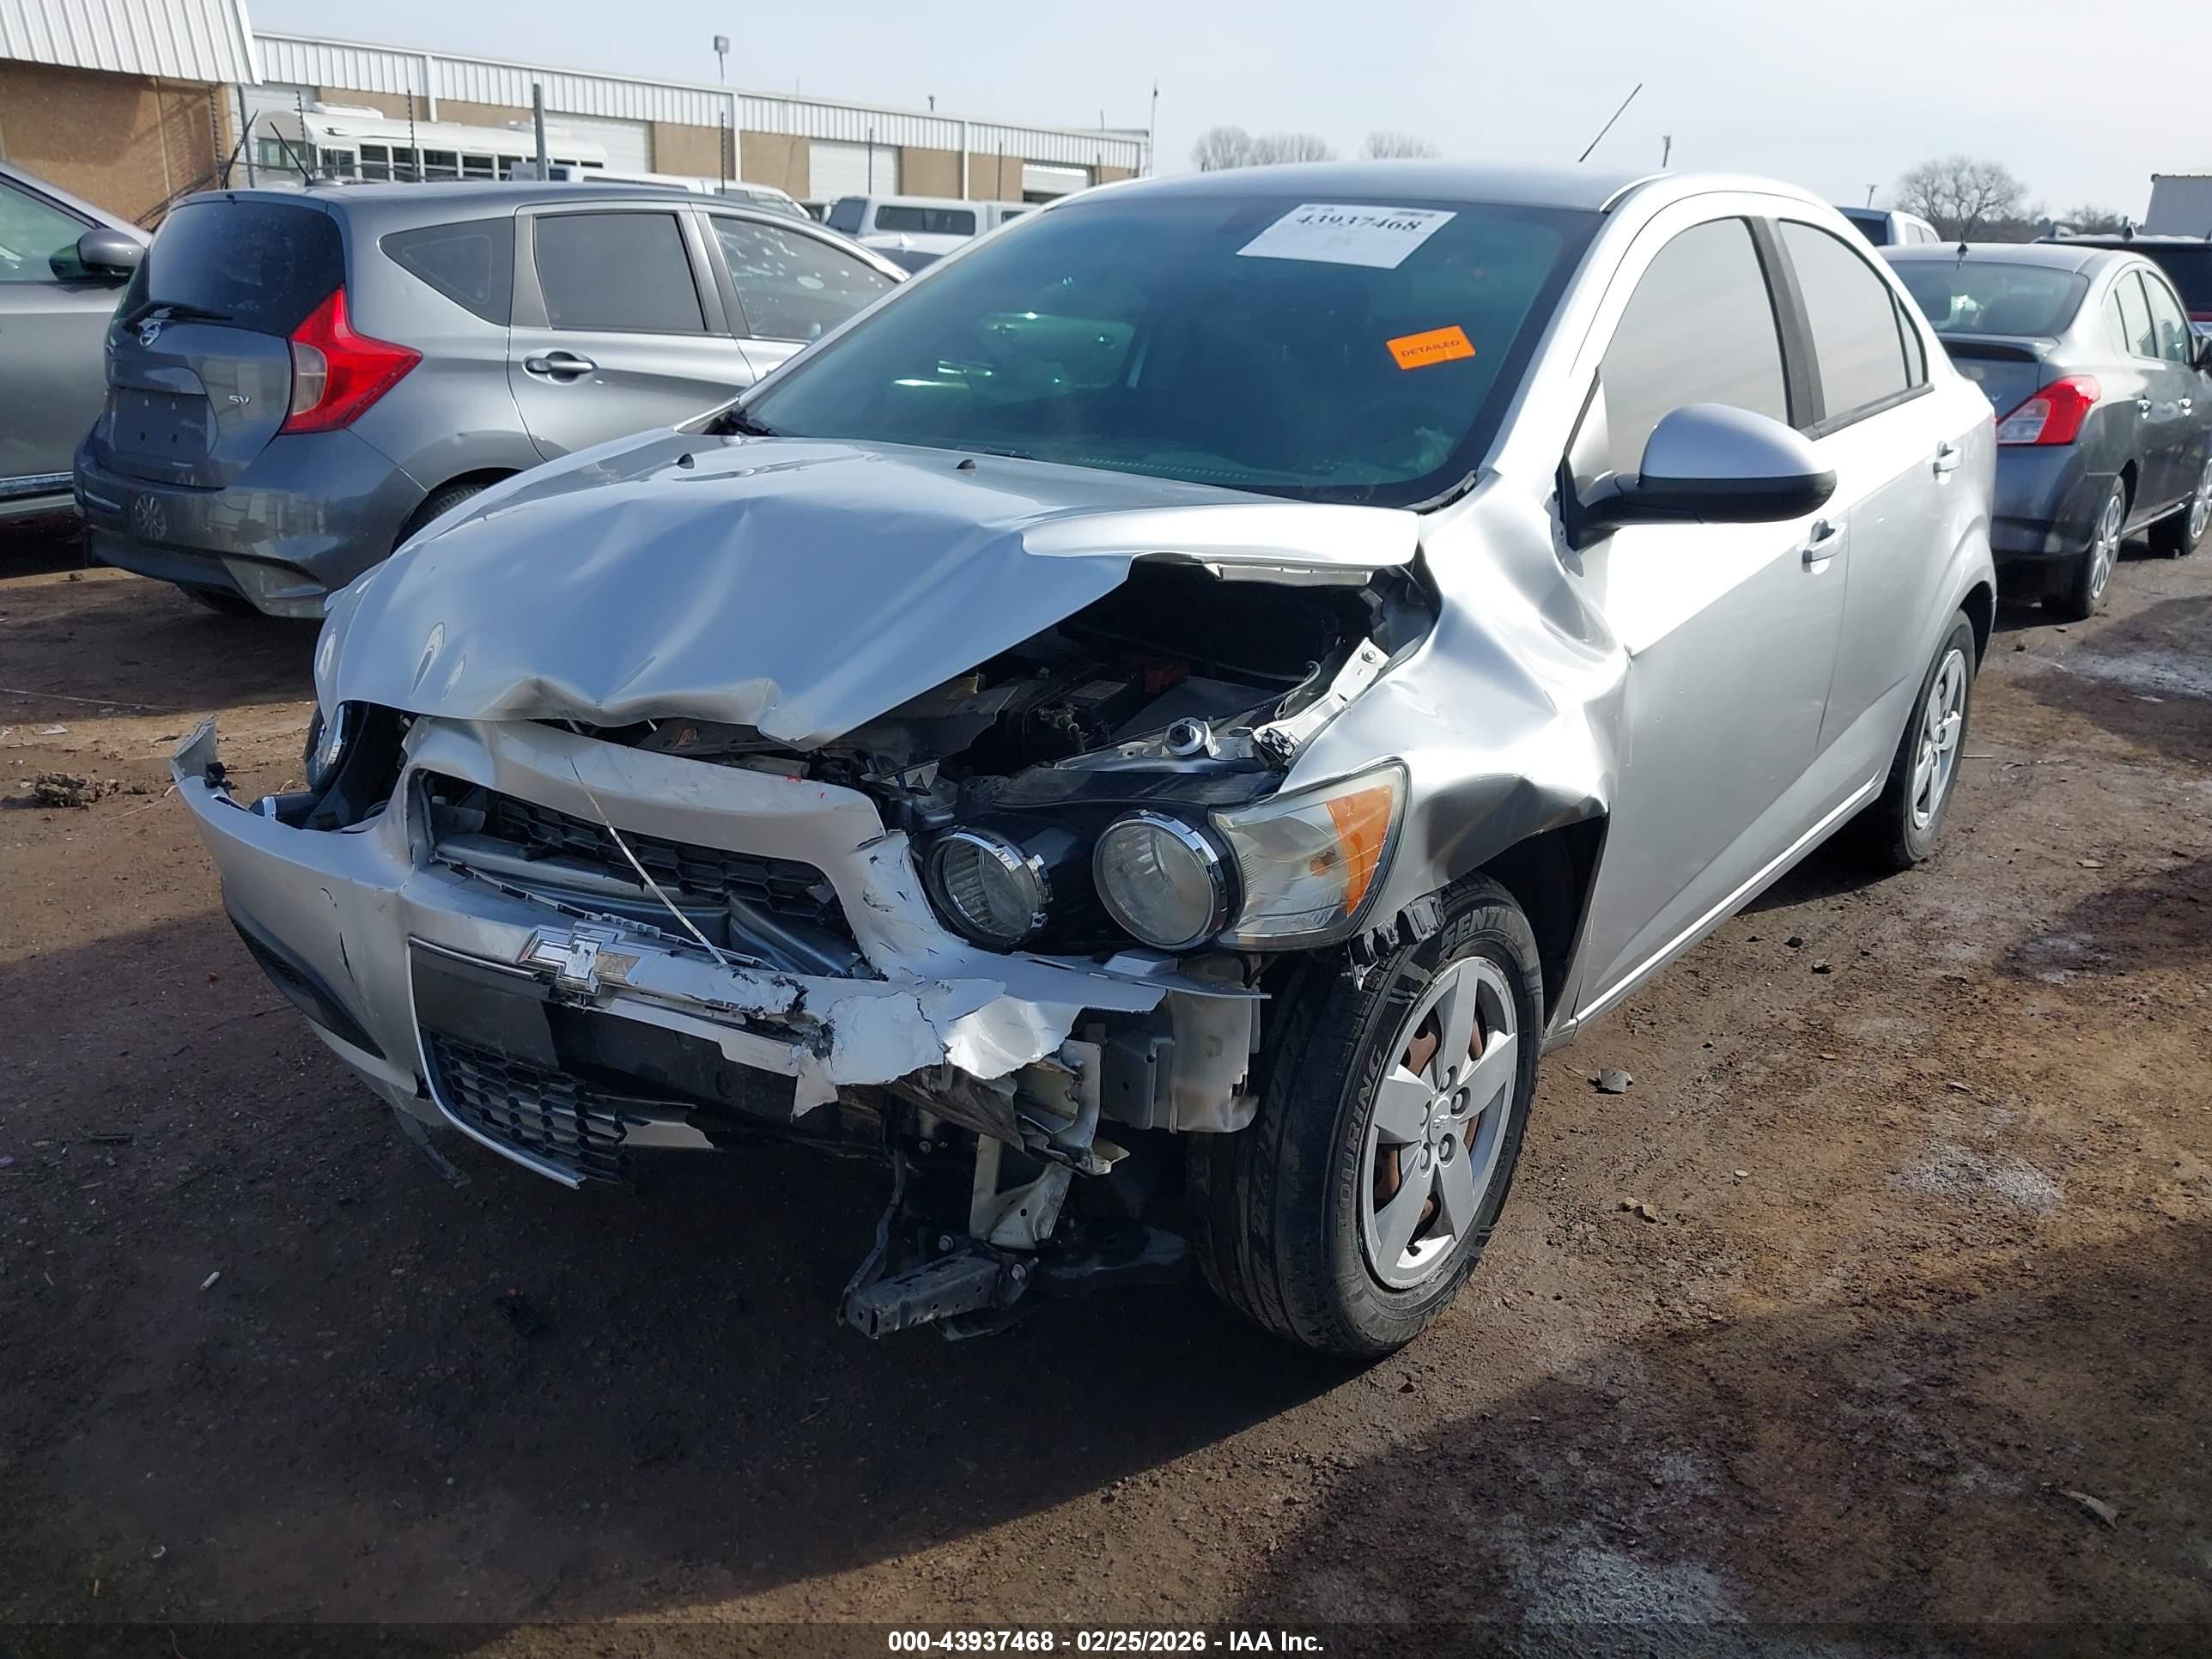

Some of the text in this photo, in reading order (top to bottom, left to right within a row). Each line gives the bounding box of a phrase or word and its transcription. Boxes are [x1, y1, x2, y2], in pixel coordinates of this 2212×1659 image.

[1401, 340, 1460, 356] DETAILED
[228, 395, 250, 404] SV
[1335, 1043, 1382, 1237] TOURING
